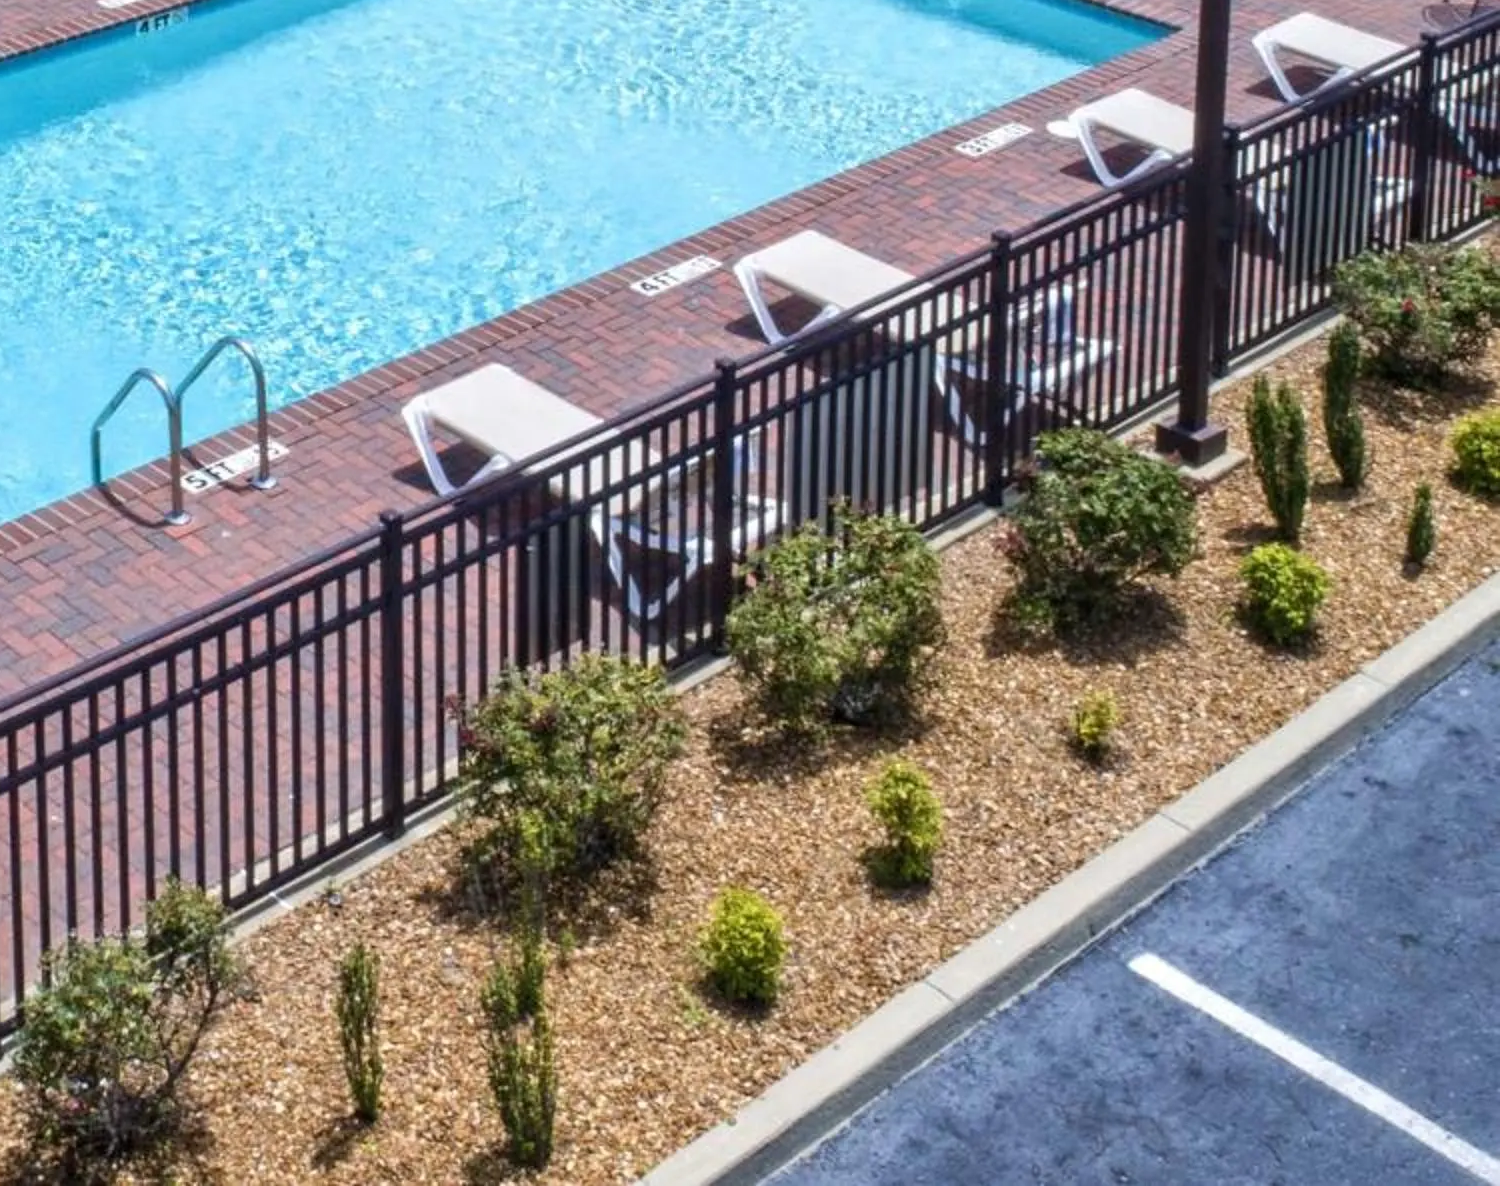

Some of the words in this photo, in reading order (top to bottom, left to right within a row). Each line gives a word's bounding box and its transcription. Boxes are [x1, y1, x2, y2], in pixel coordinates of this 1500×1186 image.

[154, 13, 171, 30] FT
[652, 271, 679, 286] FT
[204, 461, 236, 482] FT
